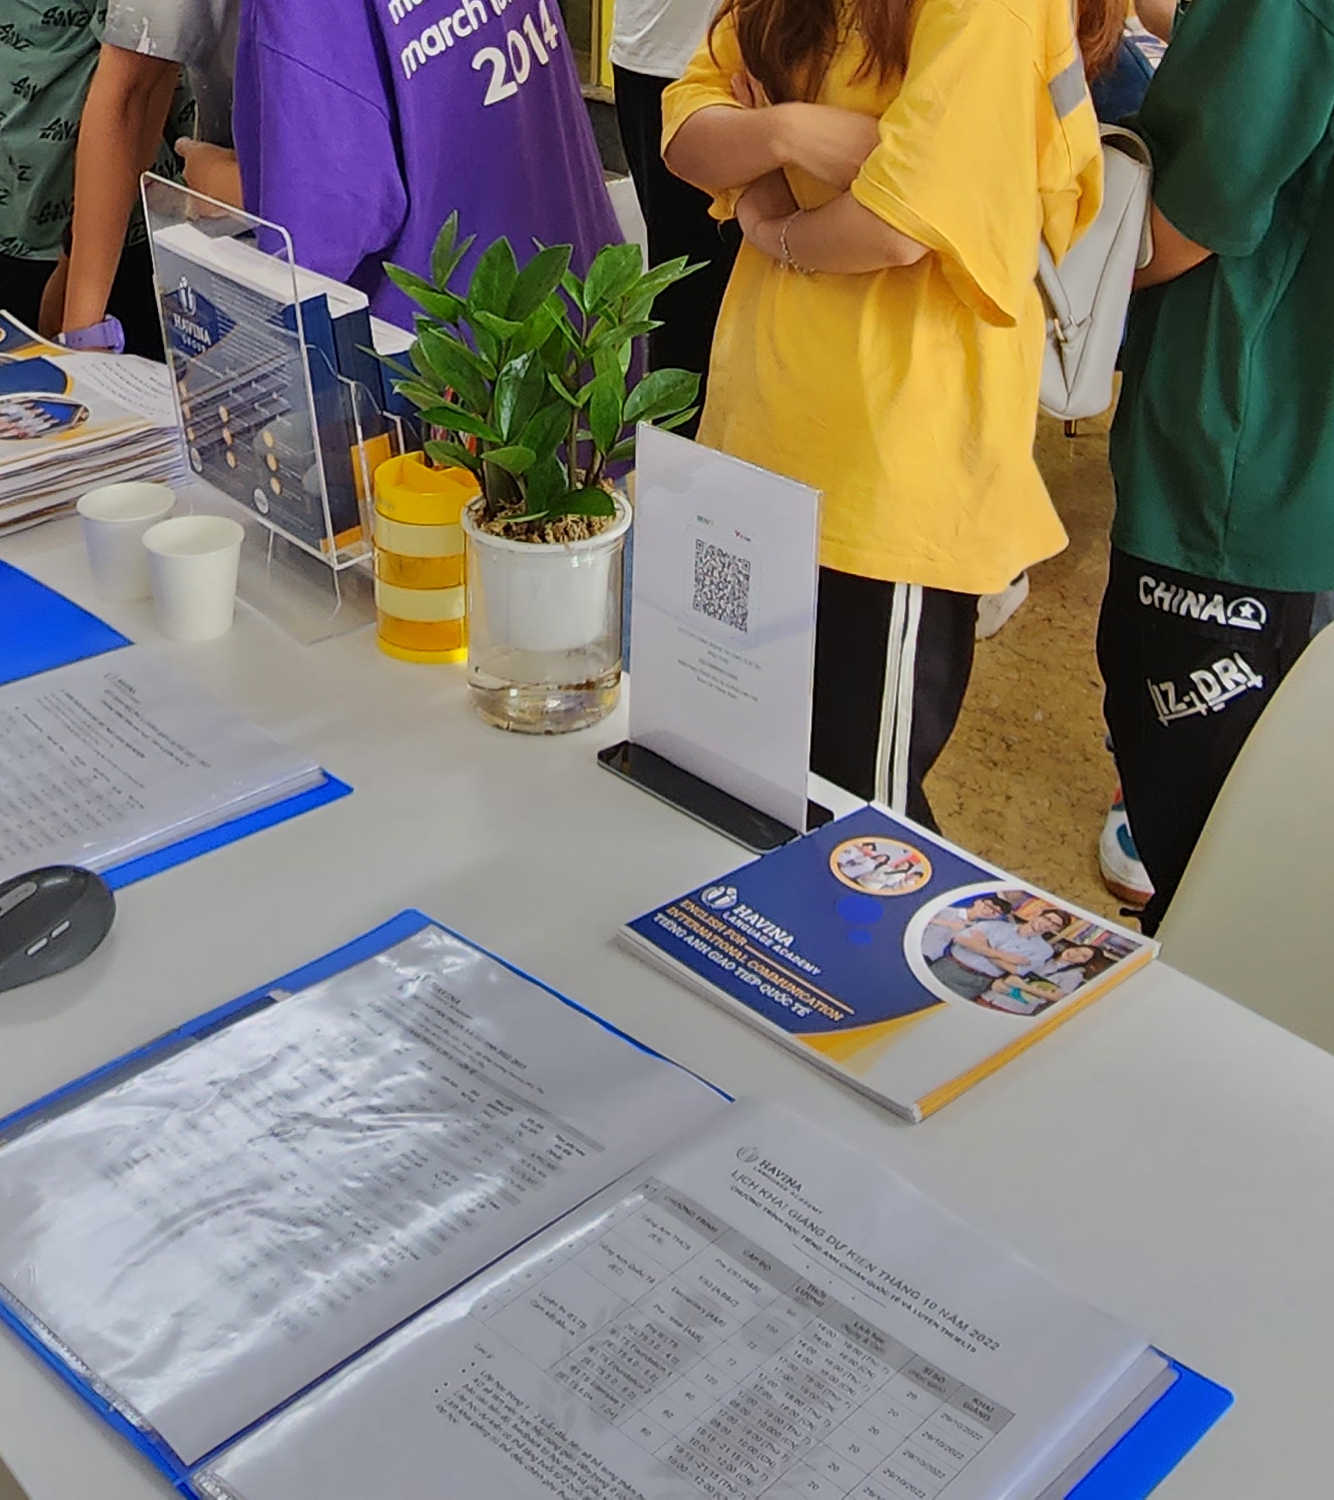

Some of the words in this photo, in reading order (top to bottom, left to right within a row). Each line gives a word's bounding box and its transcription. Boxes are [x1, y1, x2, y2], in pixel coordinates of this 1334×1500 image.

[1138, 575, 1227, 625] CHINA
[680, 899, 724, 933] ENGLISH
[723, 928, 748, 946] FOR
[722, 912, 771, 946] LANGUAGE
[771, 943, 821, 976] ACADEMY
[733, 904, 794, 947] HAVINA
[666, 907, 748, 962] INTERNATIONAL
[747, 958, 844, 1022] COMMUNICATION
[684, 934, 711, 955] ANH
[708, 949, 736, 971] GIAO
[756, 1158, 807, 1193] HAVINA
[754, 1186, 791, 1212] KHAI
[918, 1296, 939, 1311] 10
[966, 1327, 1002, 1352] 2022
